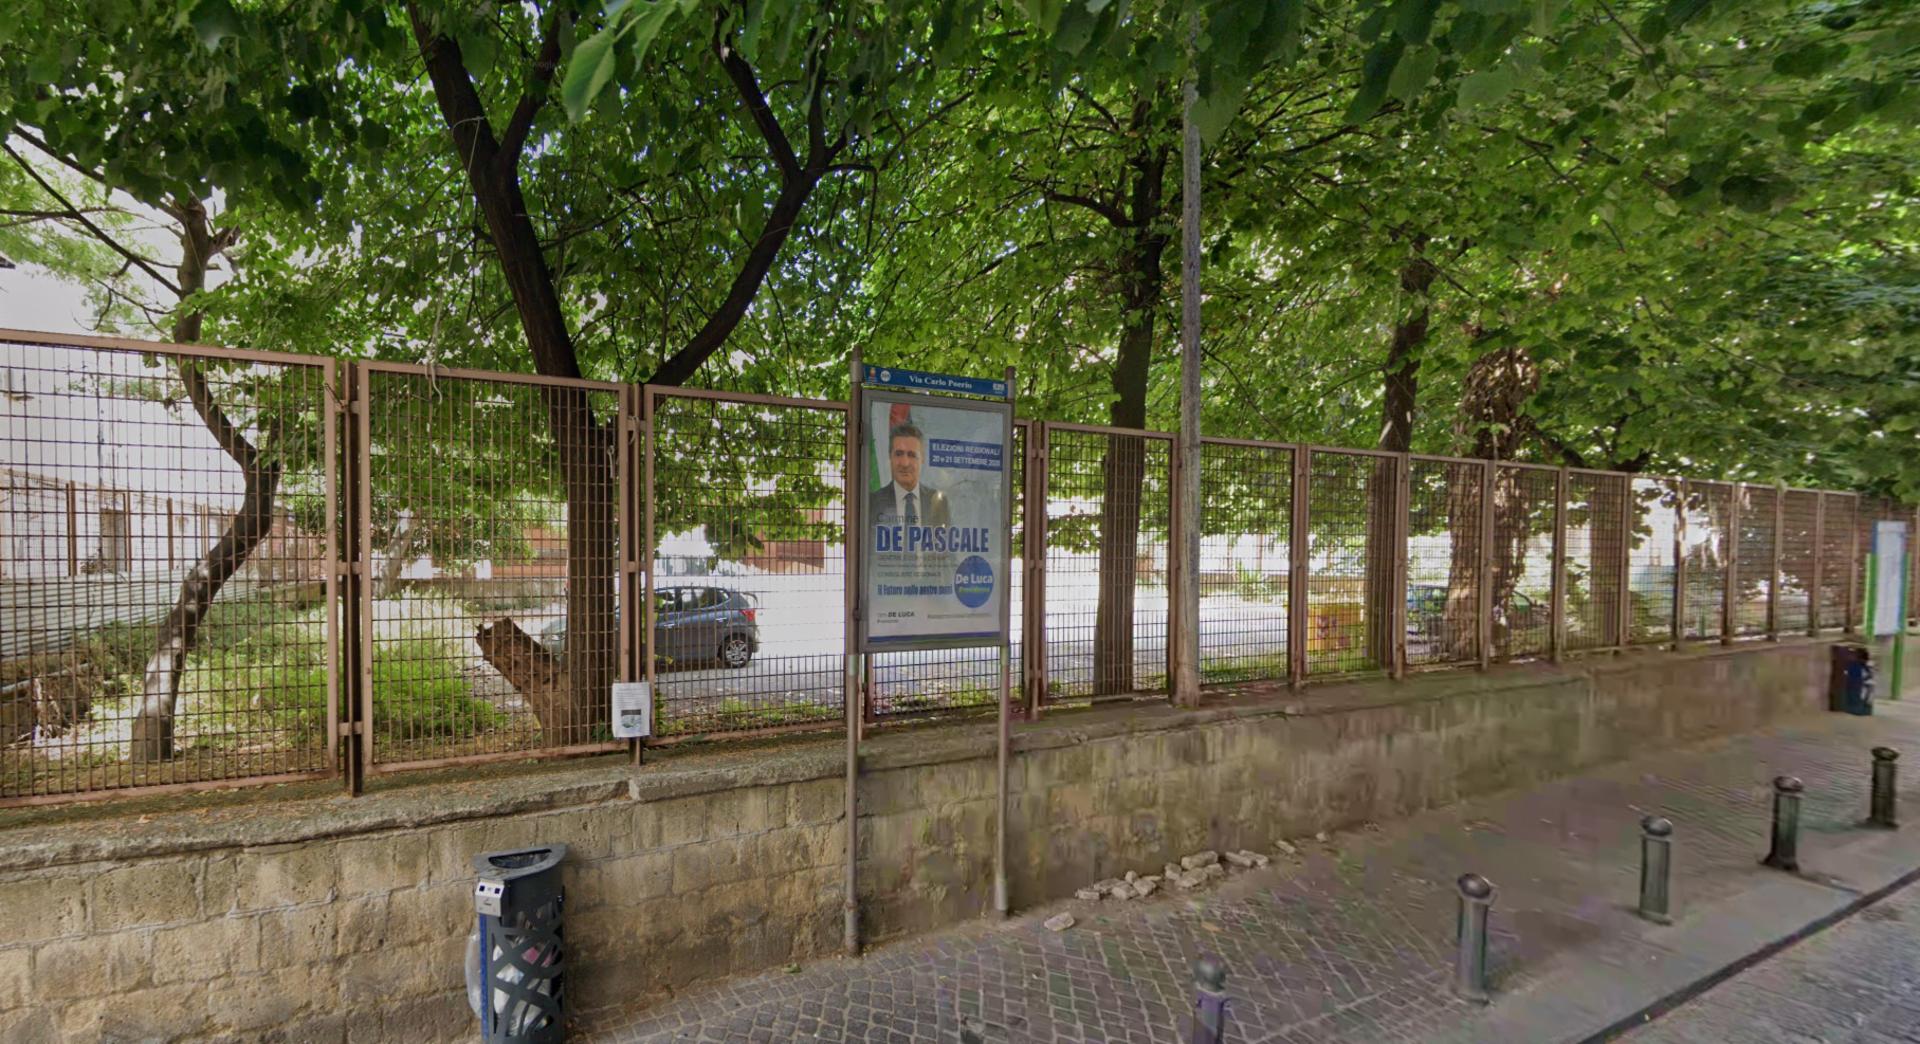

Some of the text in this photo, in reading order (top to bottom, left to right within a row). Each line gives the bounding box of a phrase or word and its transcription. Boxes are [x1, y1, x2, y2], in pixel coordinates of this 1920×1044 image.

[909, 375, 972, 389] Via Carlo Poerio
[932, 443, 1000, 456] ELEZIONI REGIONALI
[876, 525, 989, 553] DE PASCALE
[955, 574, 993, 585] De Luca
